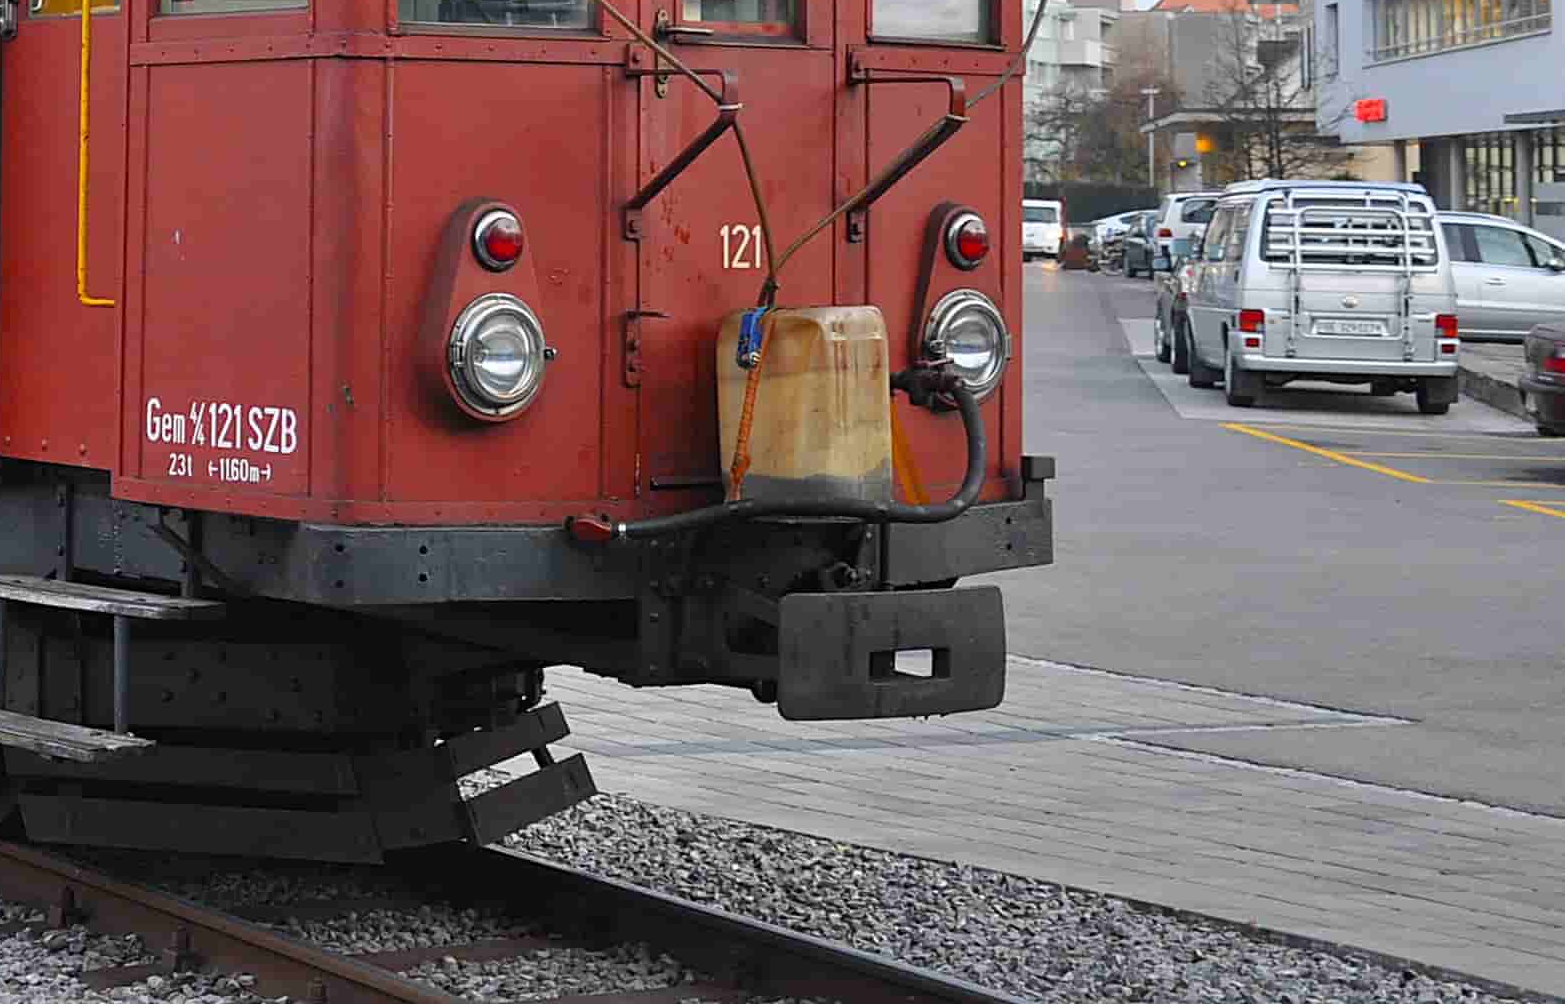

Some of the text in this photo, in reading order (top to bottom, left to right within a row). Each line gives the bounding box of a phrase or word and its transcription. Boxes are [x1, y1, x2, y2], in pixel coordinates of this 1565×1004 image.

[720, 225, 761, 269] 121
[146, 398, 186, 445] Gem
[209, 403, 242, 449] 121
[248, 406, 297, 454] SZB
